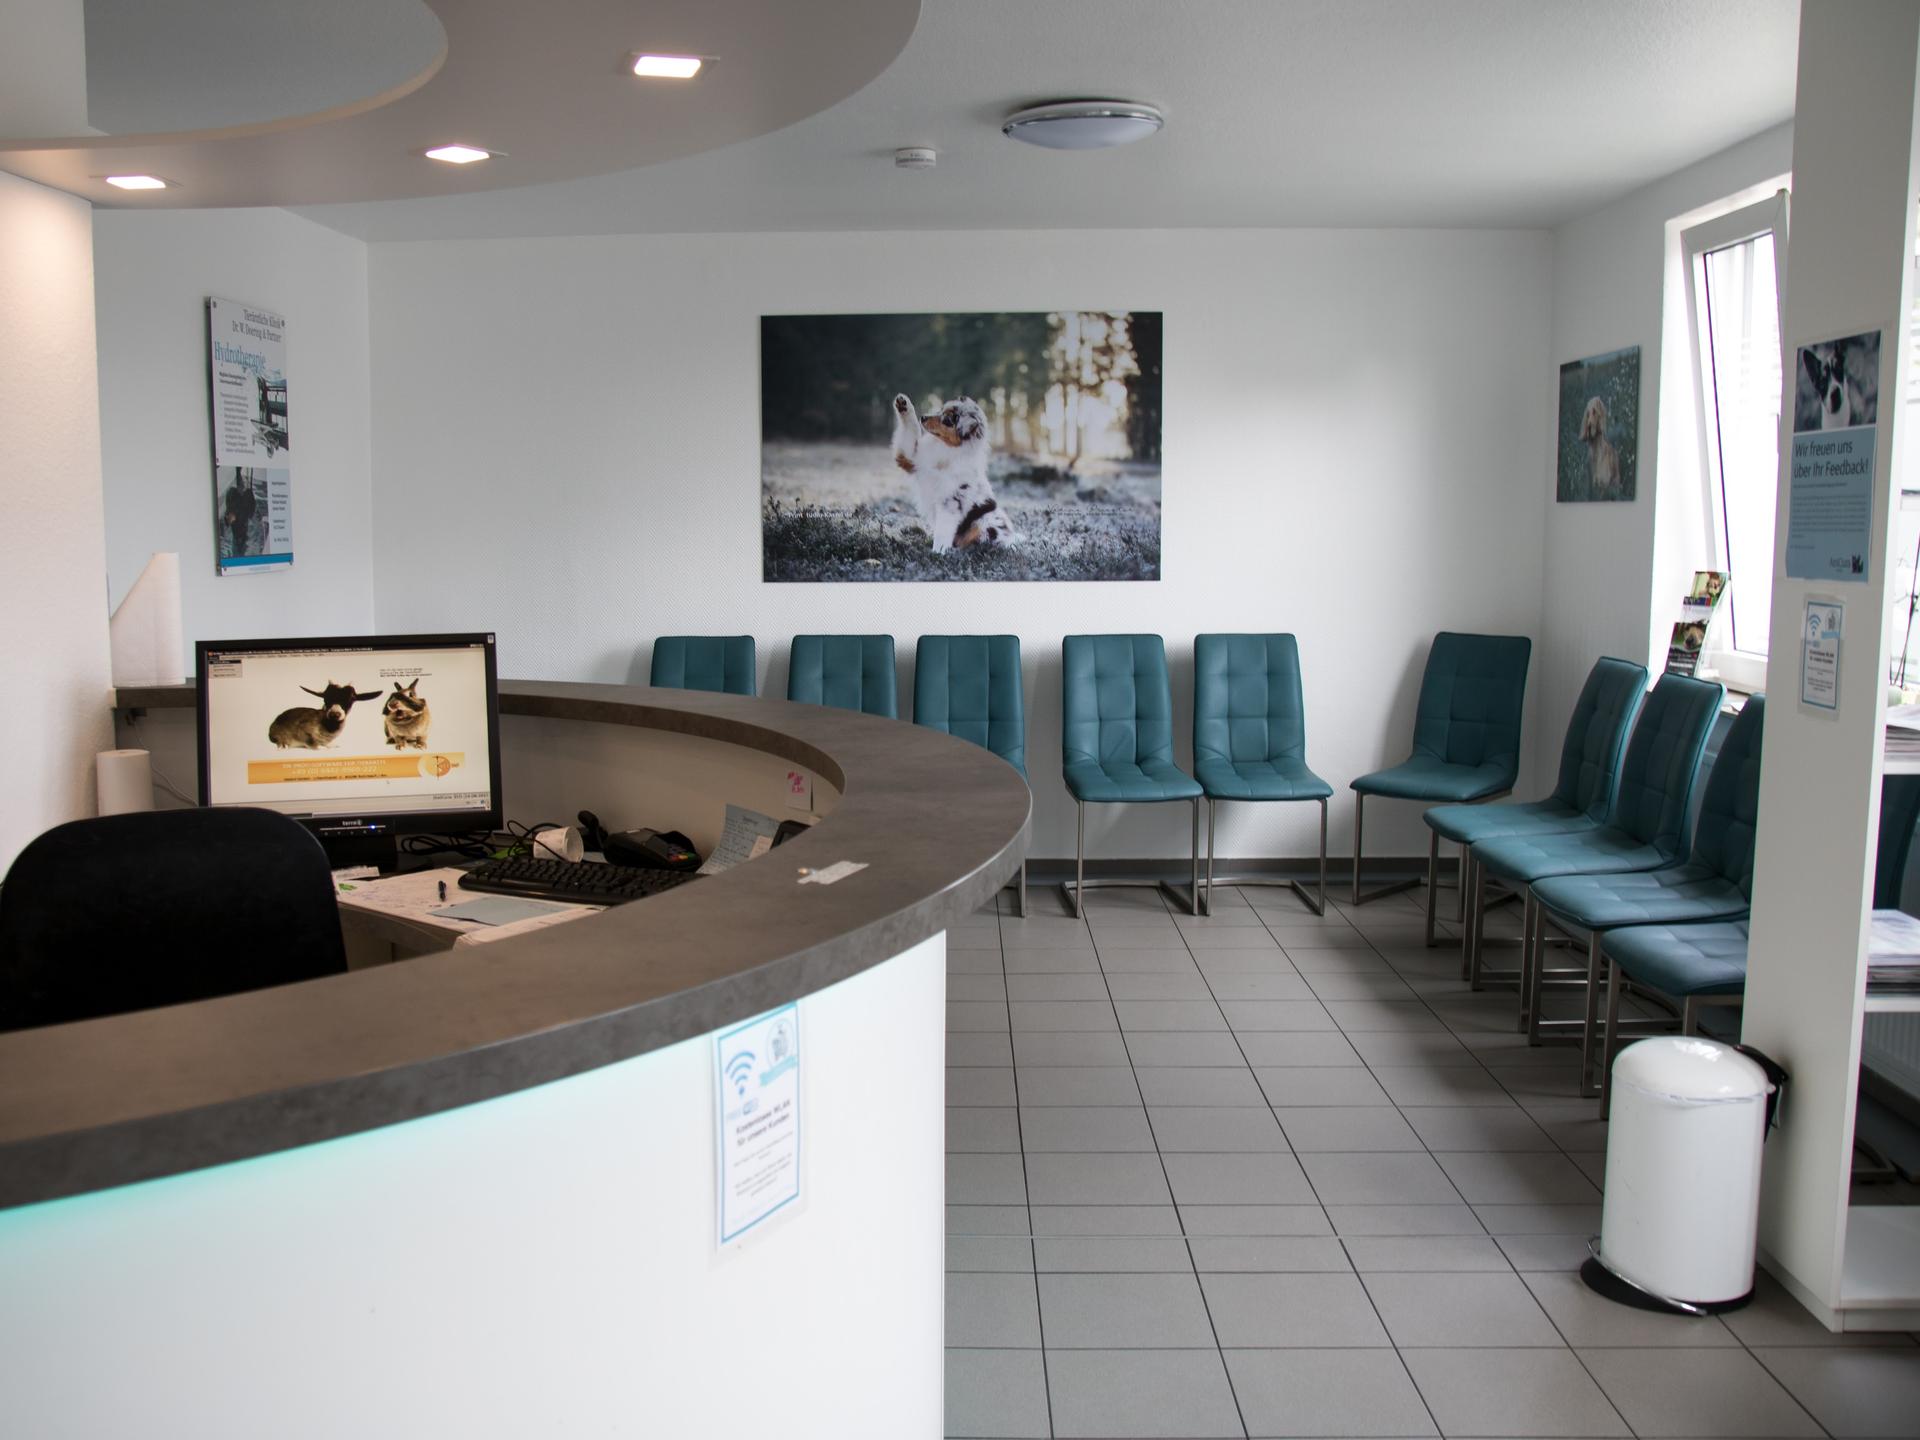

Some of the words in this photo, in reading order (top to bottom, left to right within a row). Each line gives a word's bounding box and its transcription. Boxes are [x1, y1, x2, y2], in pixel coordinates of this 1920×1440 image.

[214, 341, 266, 373] Hydrotherapie
[1795, 443, 1808, 457] Wir
[1809, 441, 1836, 456] freuen
[1837, 441, 1853, 455] uns
[1793, 463, 1811, 479] über
[1813, 461, 1824, 477] Ihr
[1825, 457, 1869, 476] Feedback!
